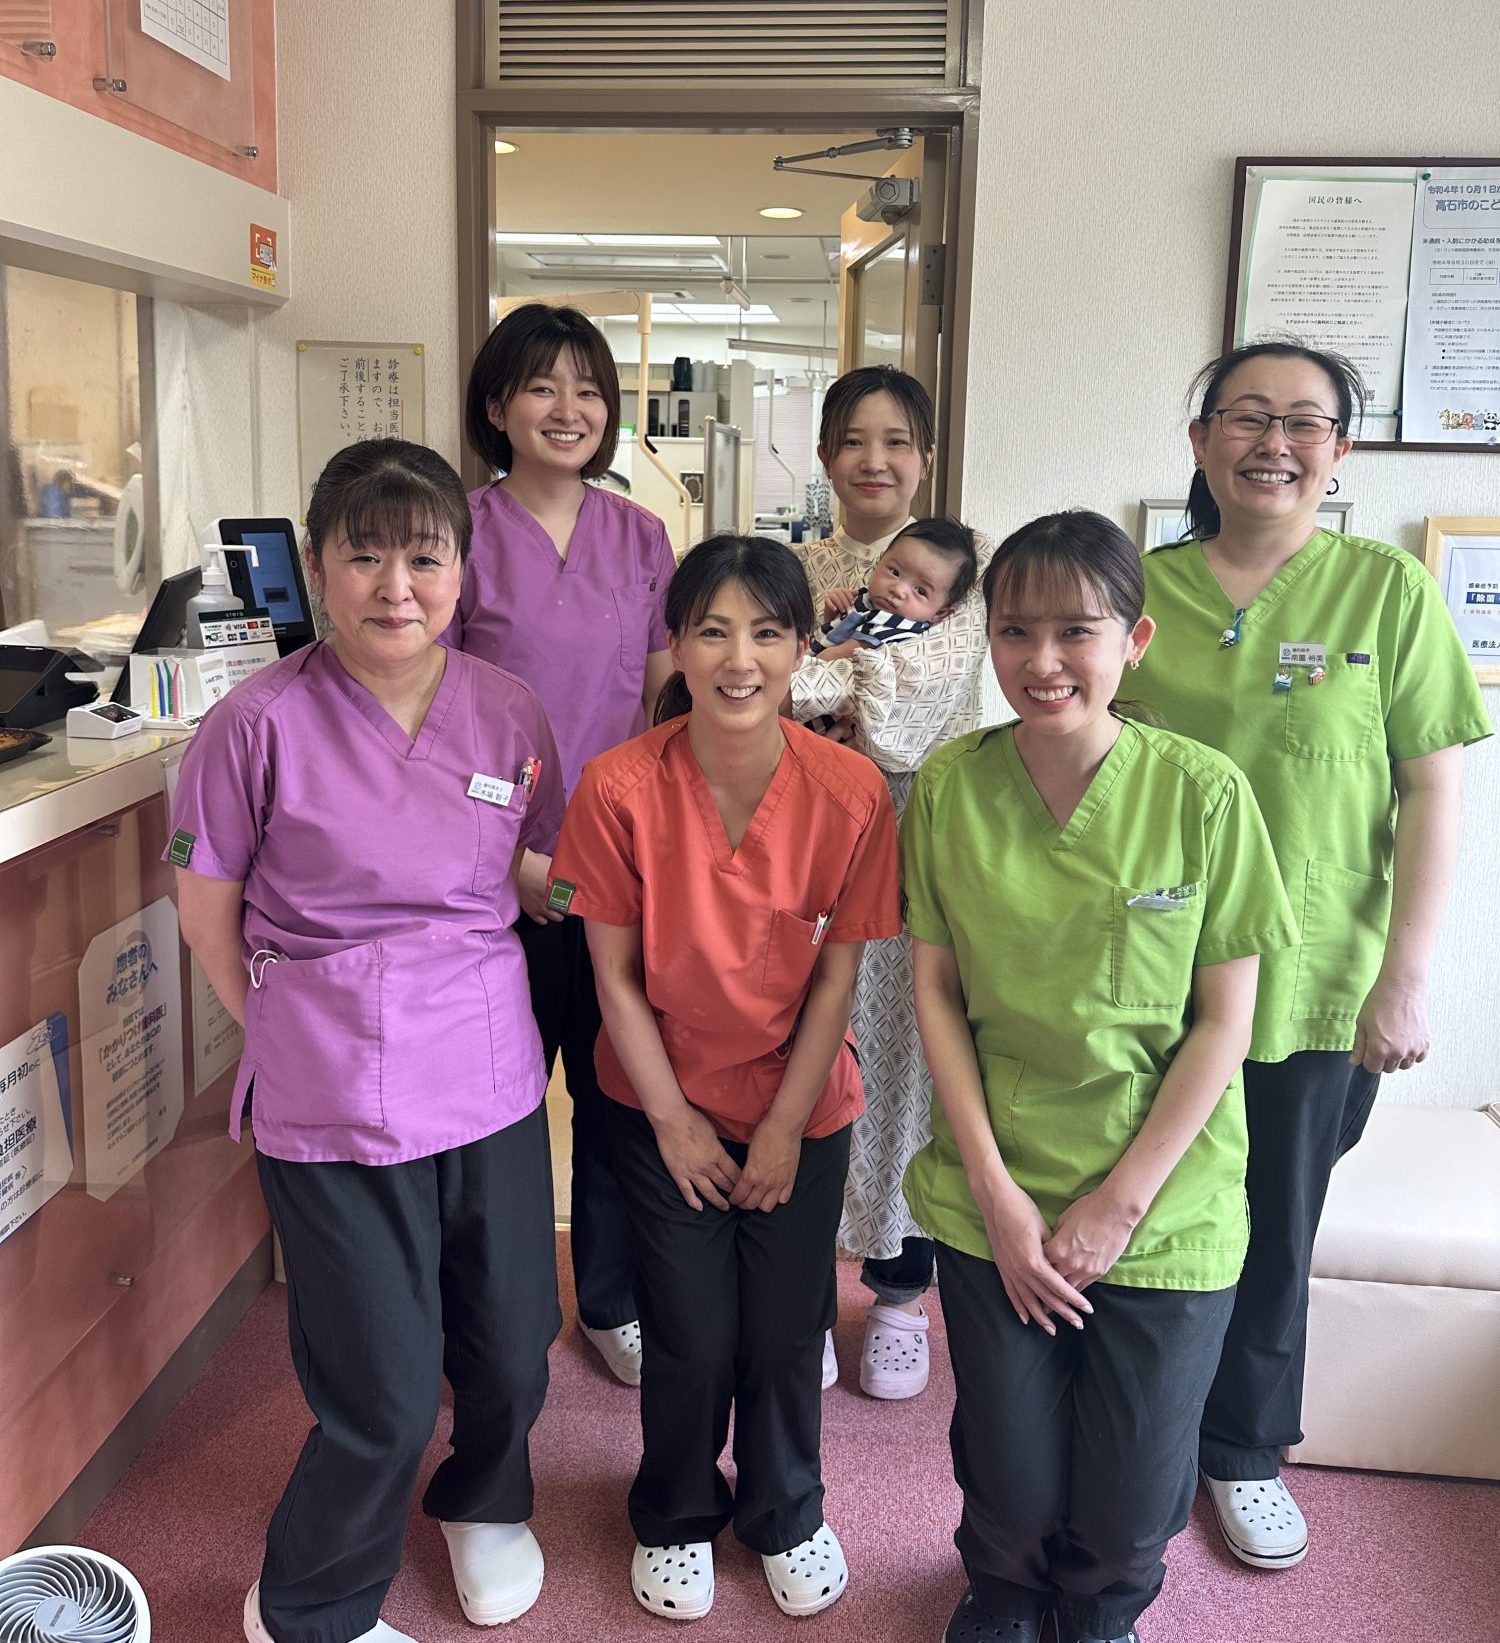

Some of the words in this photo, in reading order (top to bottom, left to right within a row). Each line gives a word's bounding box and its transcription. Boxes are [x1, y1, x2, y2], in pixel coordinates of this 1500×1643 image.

[1308, 194, 1363, 205] 国民の皆様へ
[338, 357, 351, 437] ご了承下さい。
[116, 943, 147, 975] 患者の
[106, 961, 158, 1004] みなさんへ
[99, 1002, 167, 1063] 「かかりつけ歯科医」
